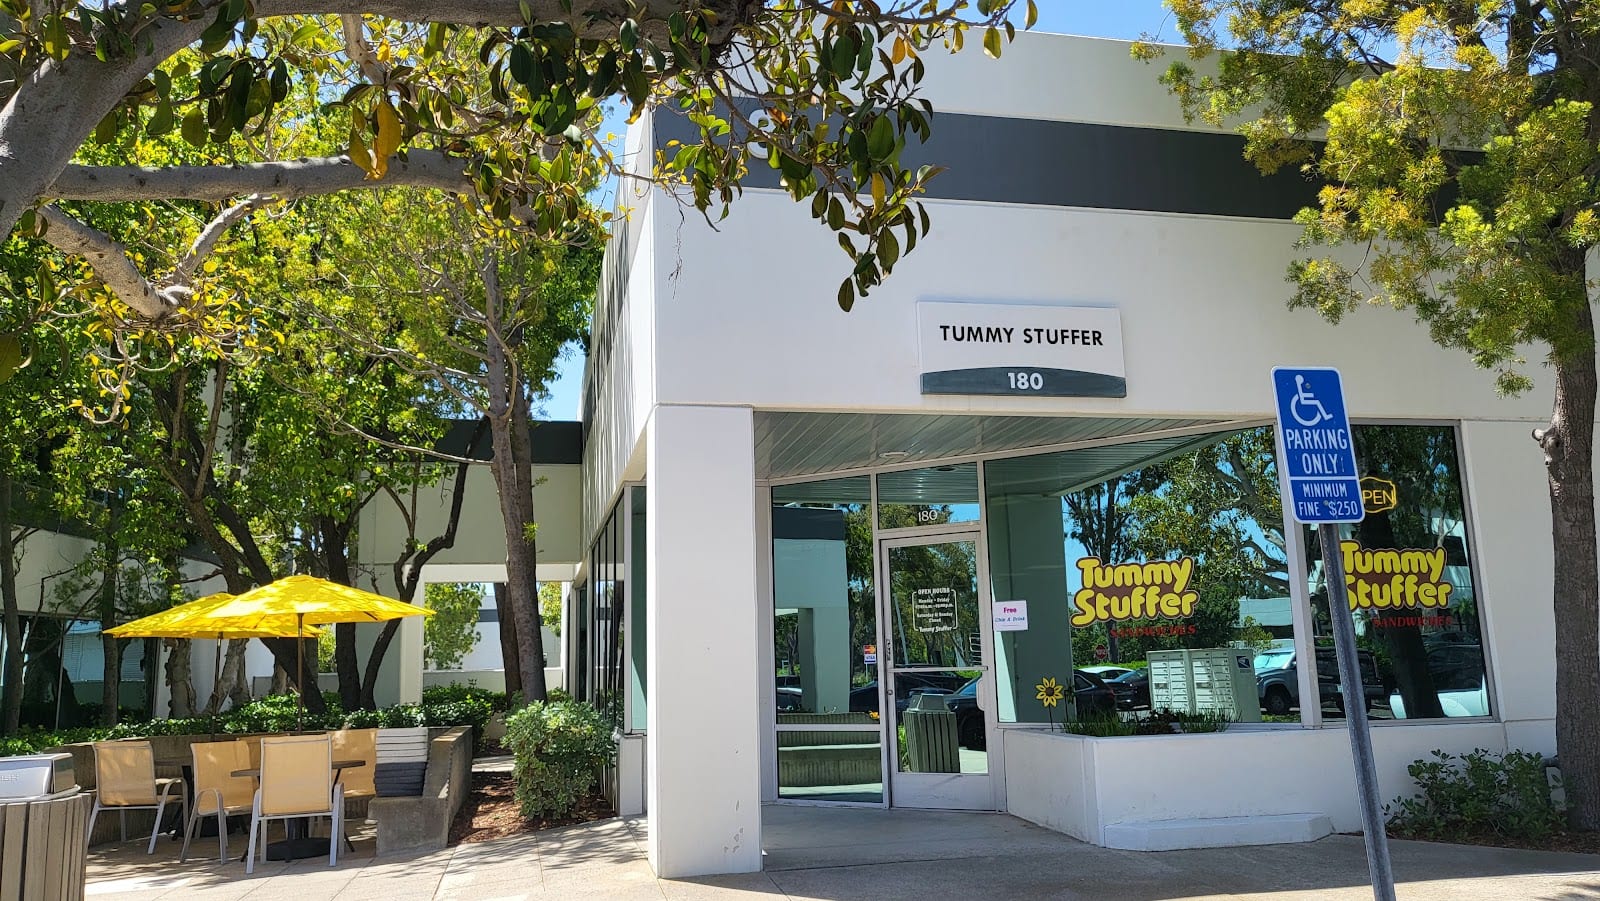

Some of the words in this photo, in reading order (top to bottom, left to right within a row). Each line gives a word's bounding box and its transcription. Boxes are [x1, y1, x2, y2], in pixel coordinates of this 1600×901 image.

[940, 325, 1014, 343] TUMMY
[1023, 327, 1104, 346] STUFFER
[1007, 372, 1044, 390] 180
[1285, 428, 1348, 450] PARKING
[1301, 453, 1338, 474] ONLY
[1302, 482, 1348, 498] MINIMUM
[1362, 489, 1395, 505] PEN
[918, 510, 938, 522] 180
[1298, 501, 1321, 516] FINE
[1328, 500, 1358, 518] $250
[1341, 541, 1446, 584] Tummy
[1077, 557, 1193, 593] Tummy
[1071, 585, 1198, 625] Stuffer
